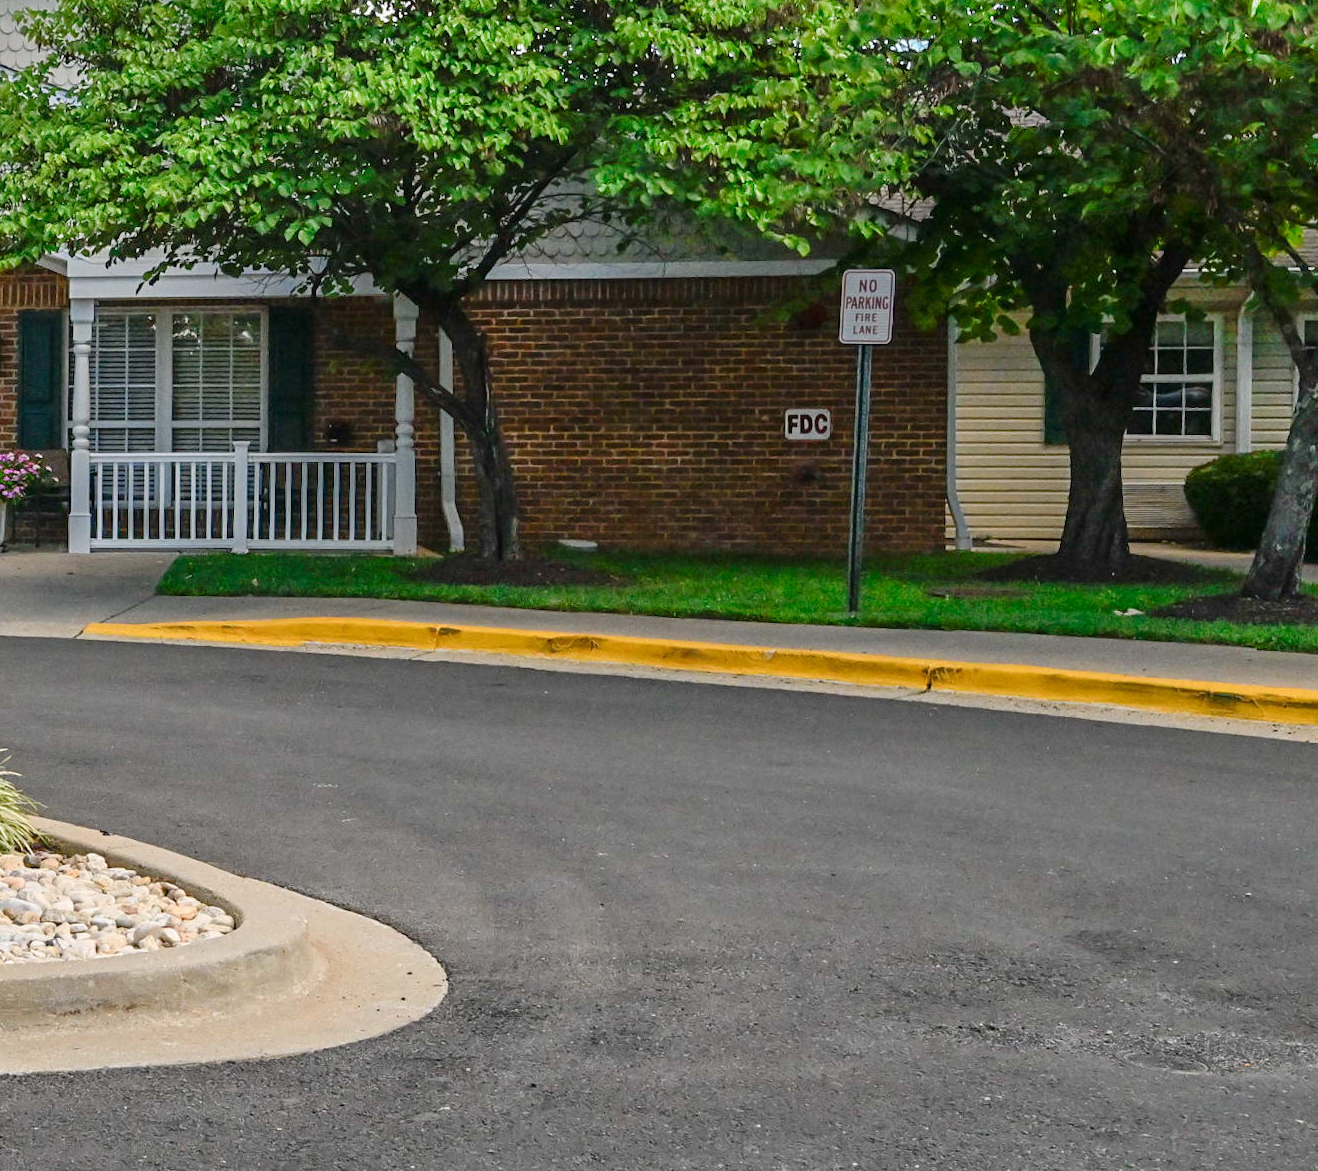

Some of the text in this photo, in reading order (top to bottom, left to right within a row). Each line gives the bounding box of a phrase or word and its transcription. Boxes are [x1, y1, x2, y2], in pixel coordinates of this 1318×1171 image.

[858, 279, 878, 293] NO
[845, 296, 889, 310] PARKING
[855, 313, 877, 323] FIRE
[852, 325, 878, 335] LANE
[787, 414, 828, 434] FDC
